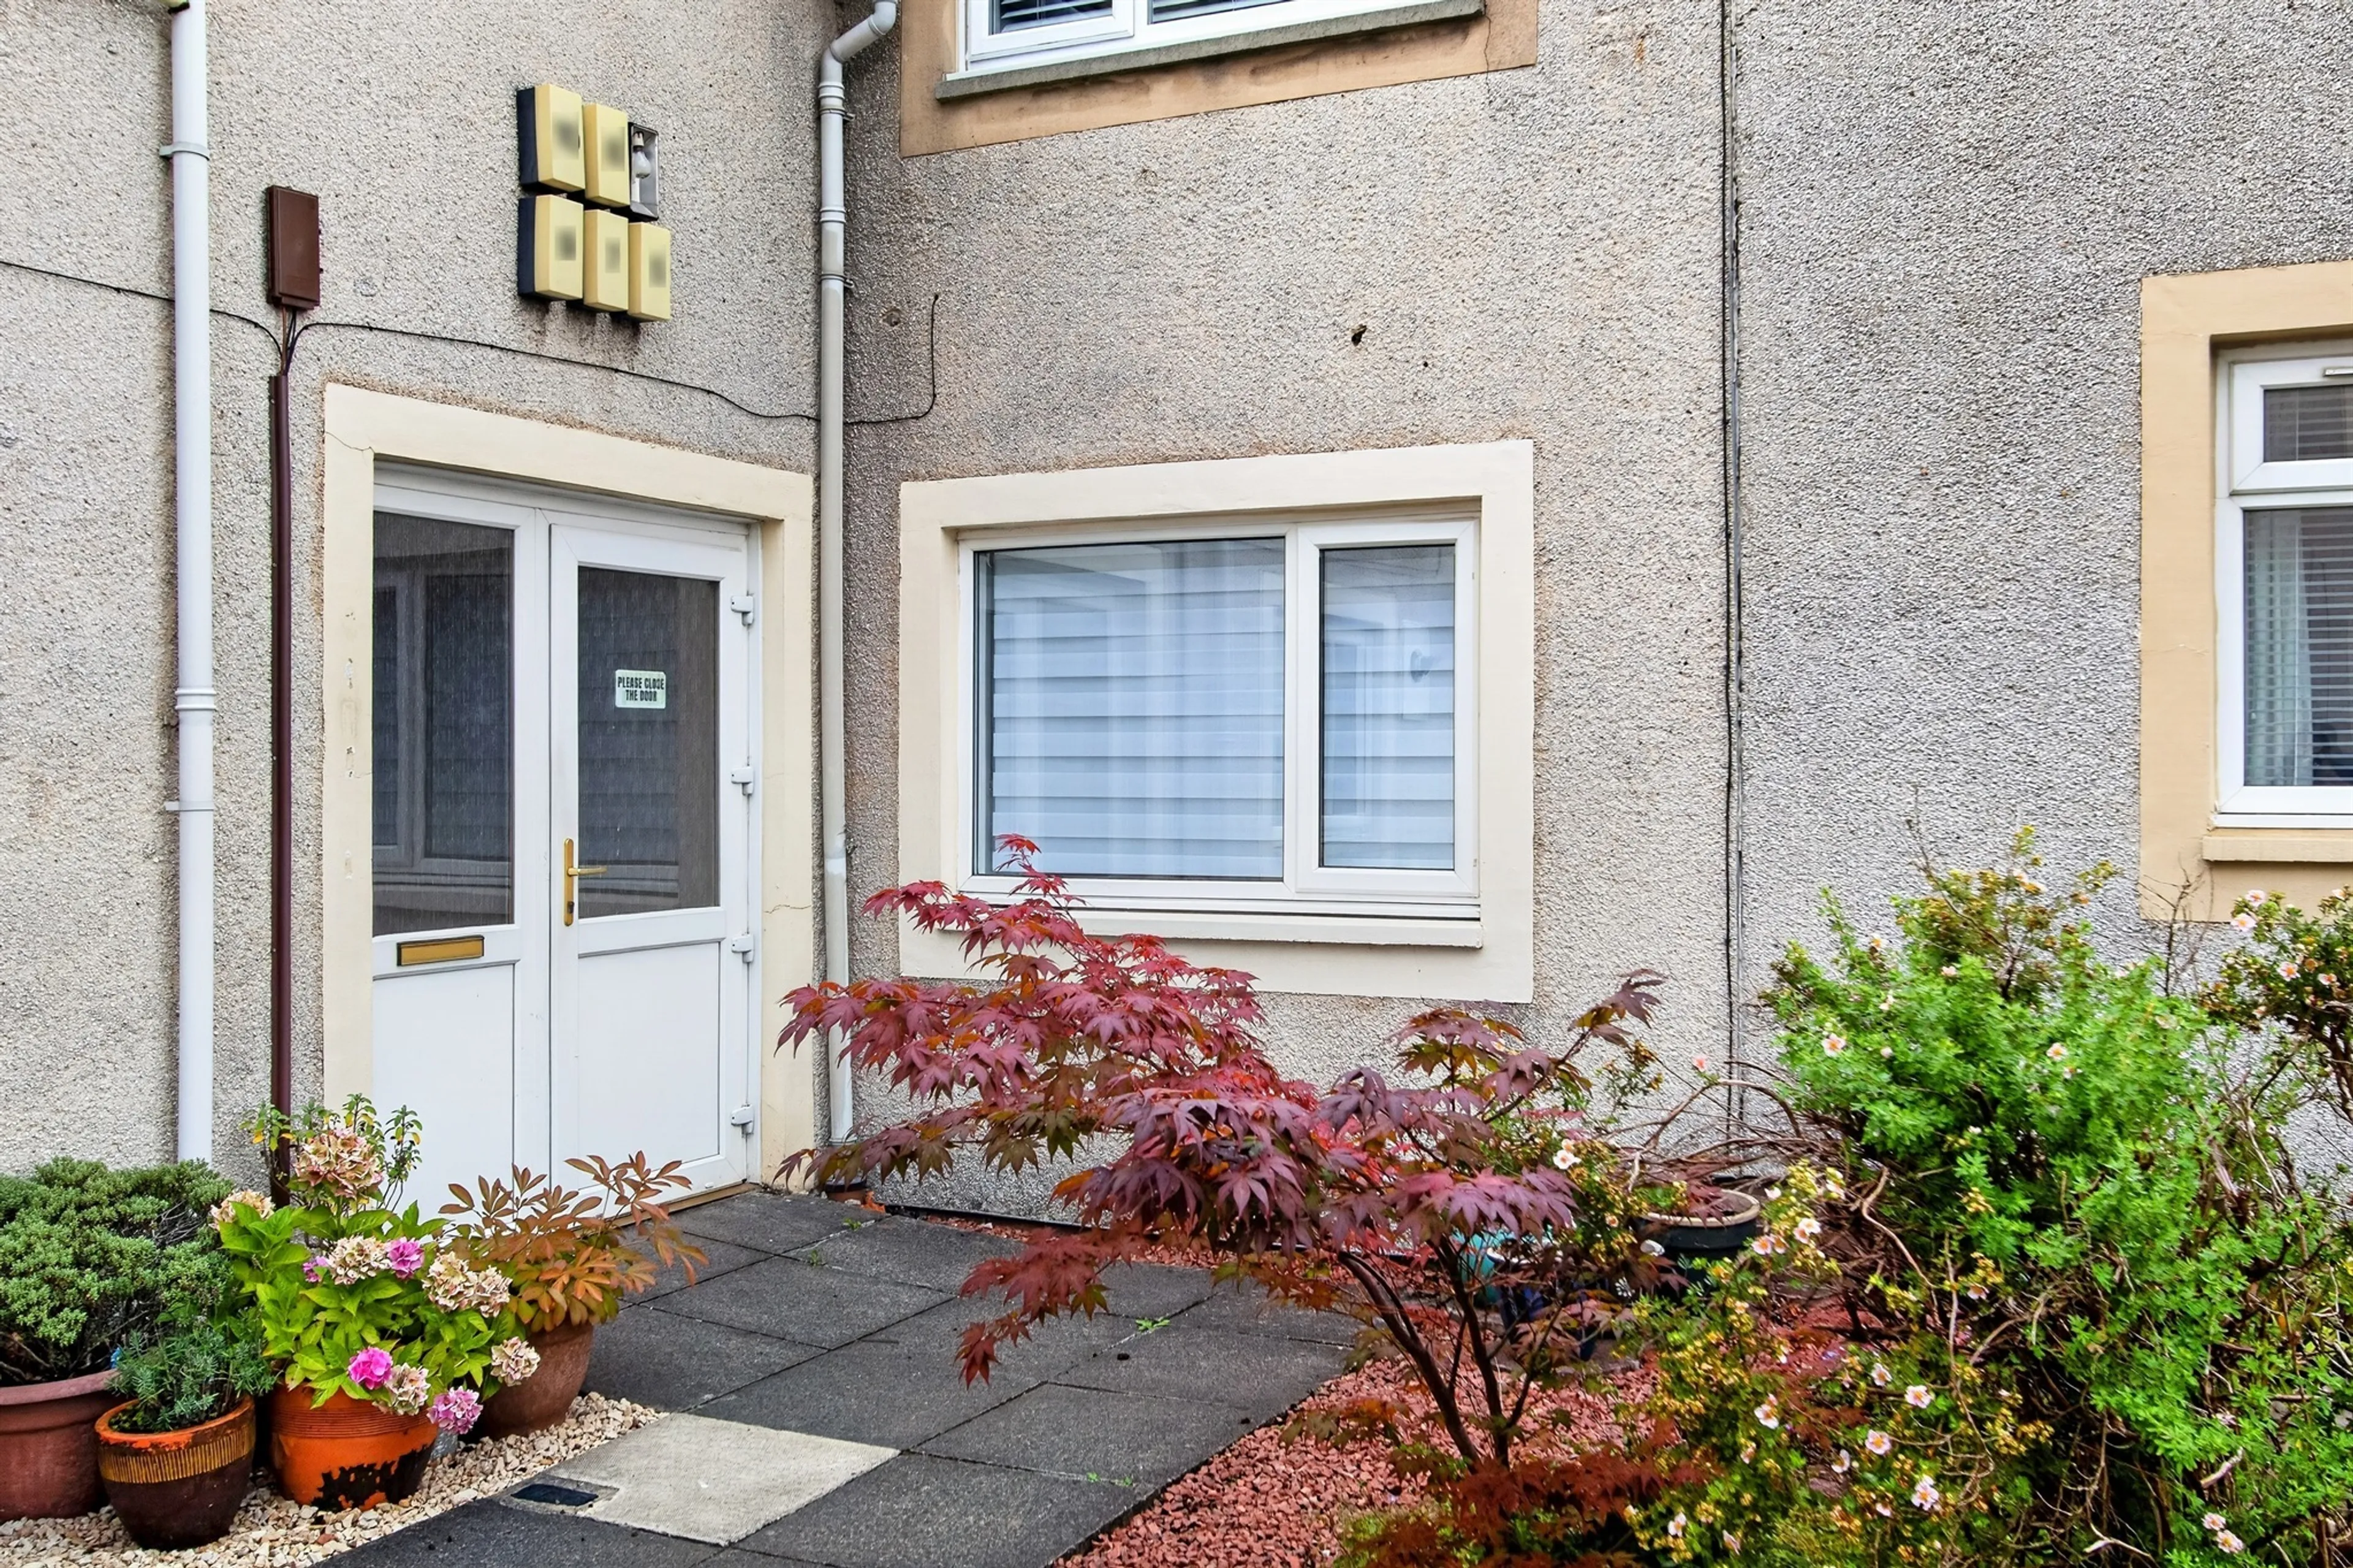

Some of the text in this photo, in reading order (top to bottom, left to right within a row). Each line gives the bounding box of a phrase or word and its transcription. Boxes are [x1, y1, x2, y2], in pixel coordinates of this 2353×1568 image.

[618, 676, 664, 690] PLEASE CLOSE
[626, 689, 657, 702] THE DOOR
